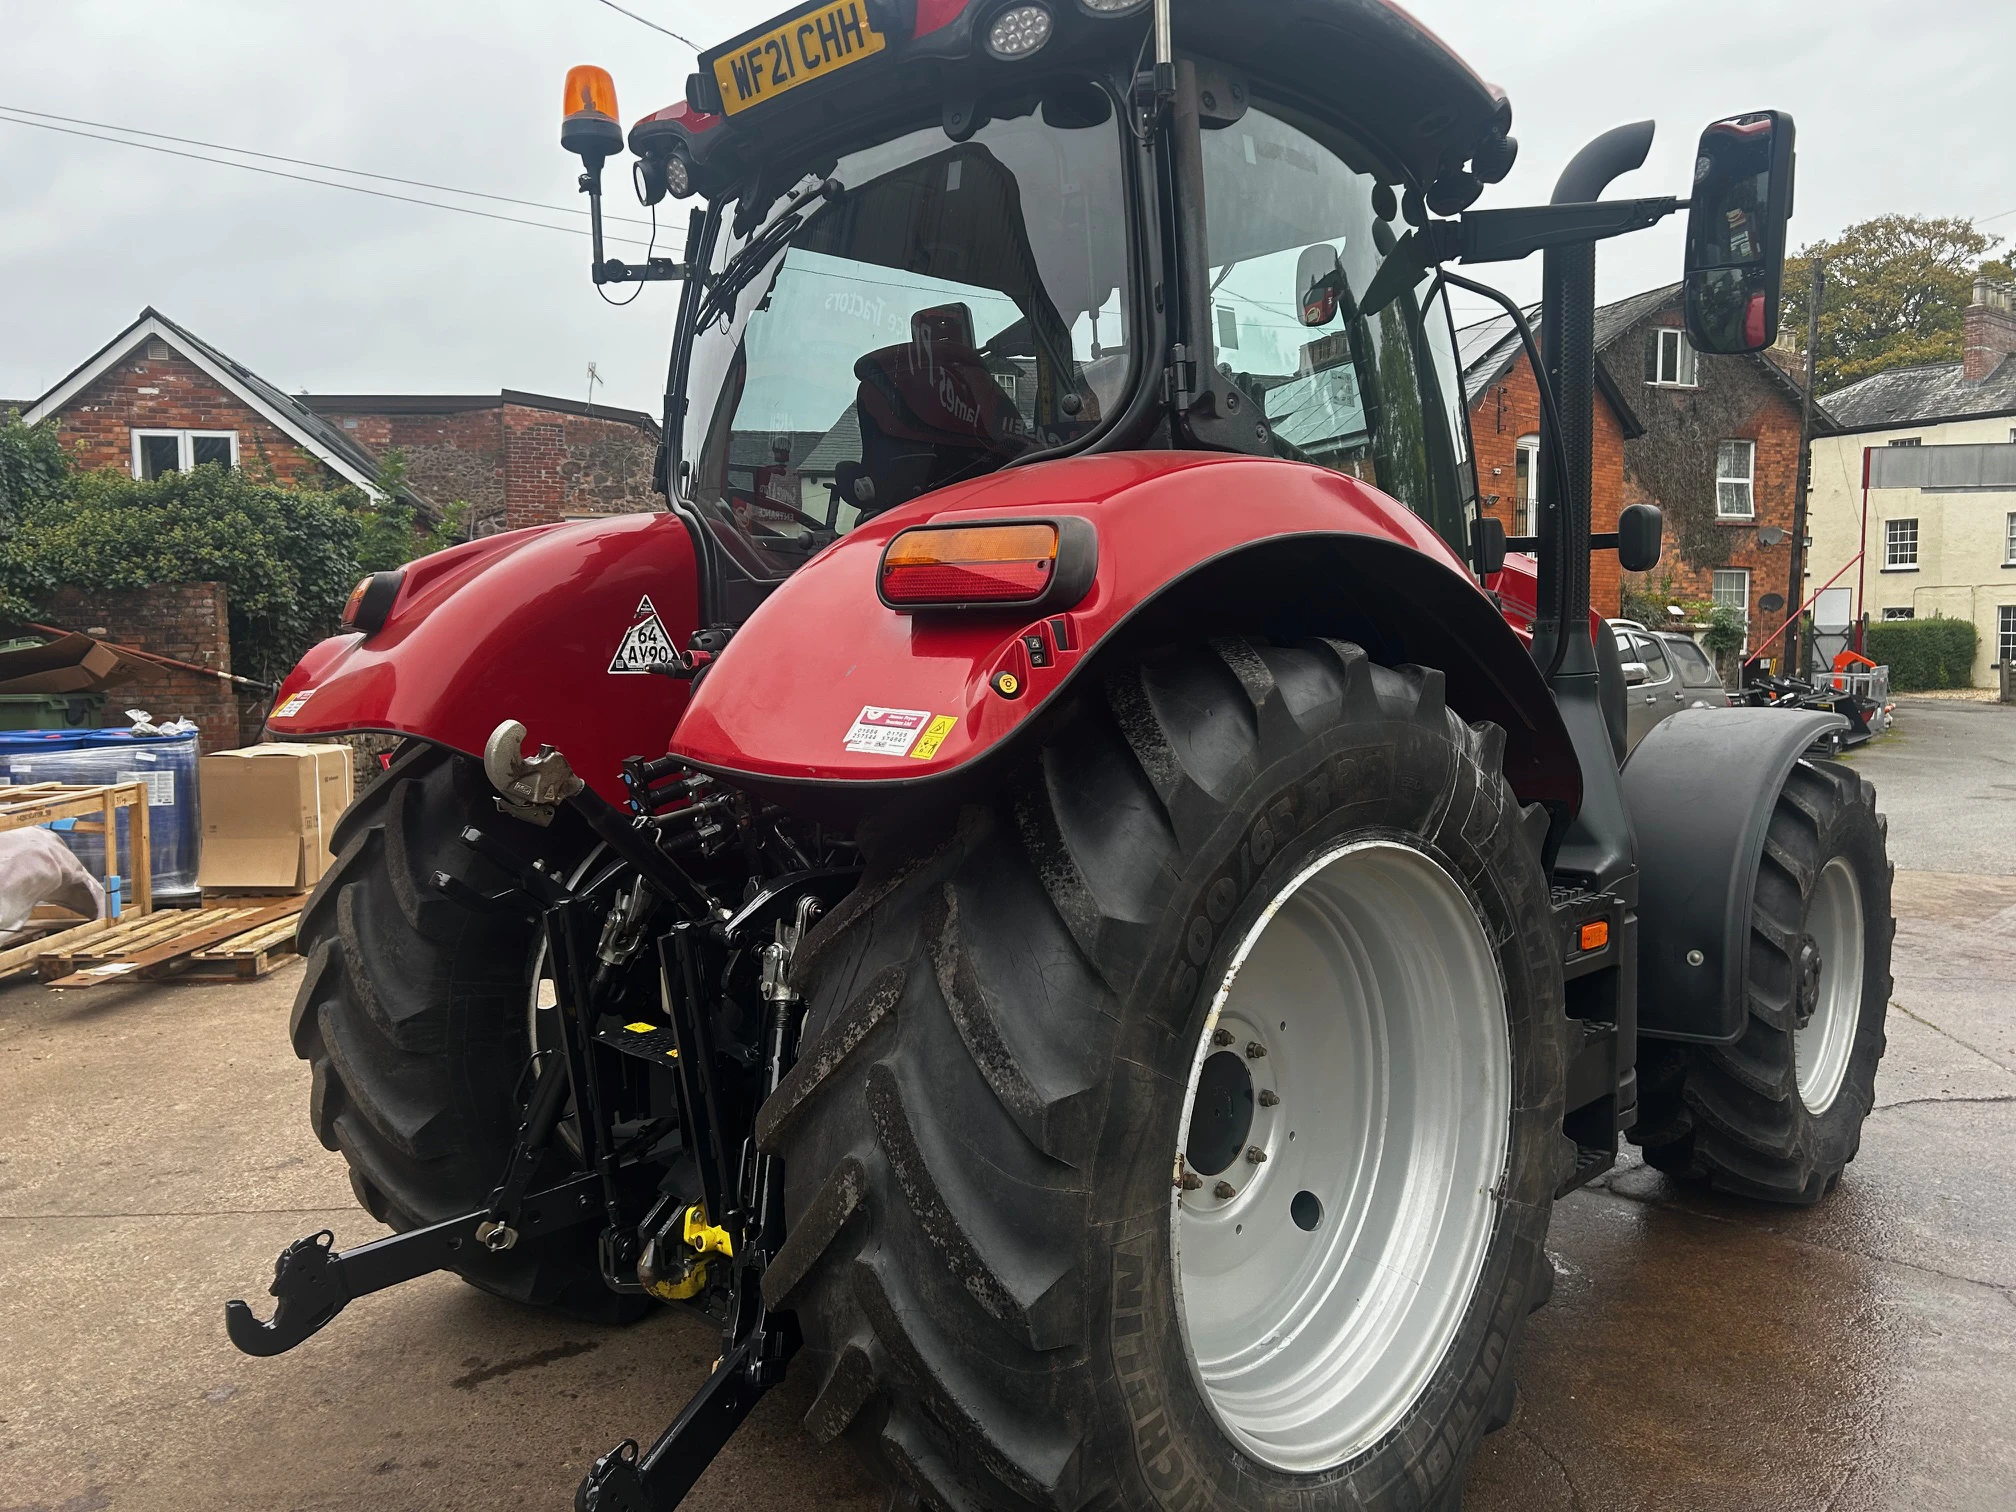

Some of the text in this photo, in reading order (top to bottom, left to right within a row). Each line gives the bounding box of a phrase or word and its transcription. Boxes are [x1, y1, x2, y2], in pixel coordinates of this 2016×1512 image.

[730, 2, 865, 101] WF21 CHH
[628, 646, 668, 664] AY90
[638, 626, 657, 644] 64
[1113, 1252, 1213, 1512] ICHELIN
